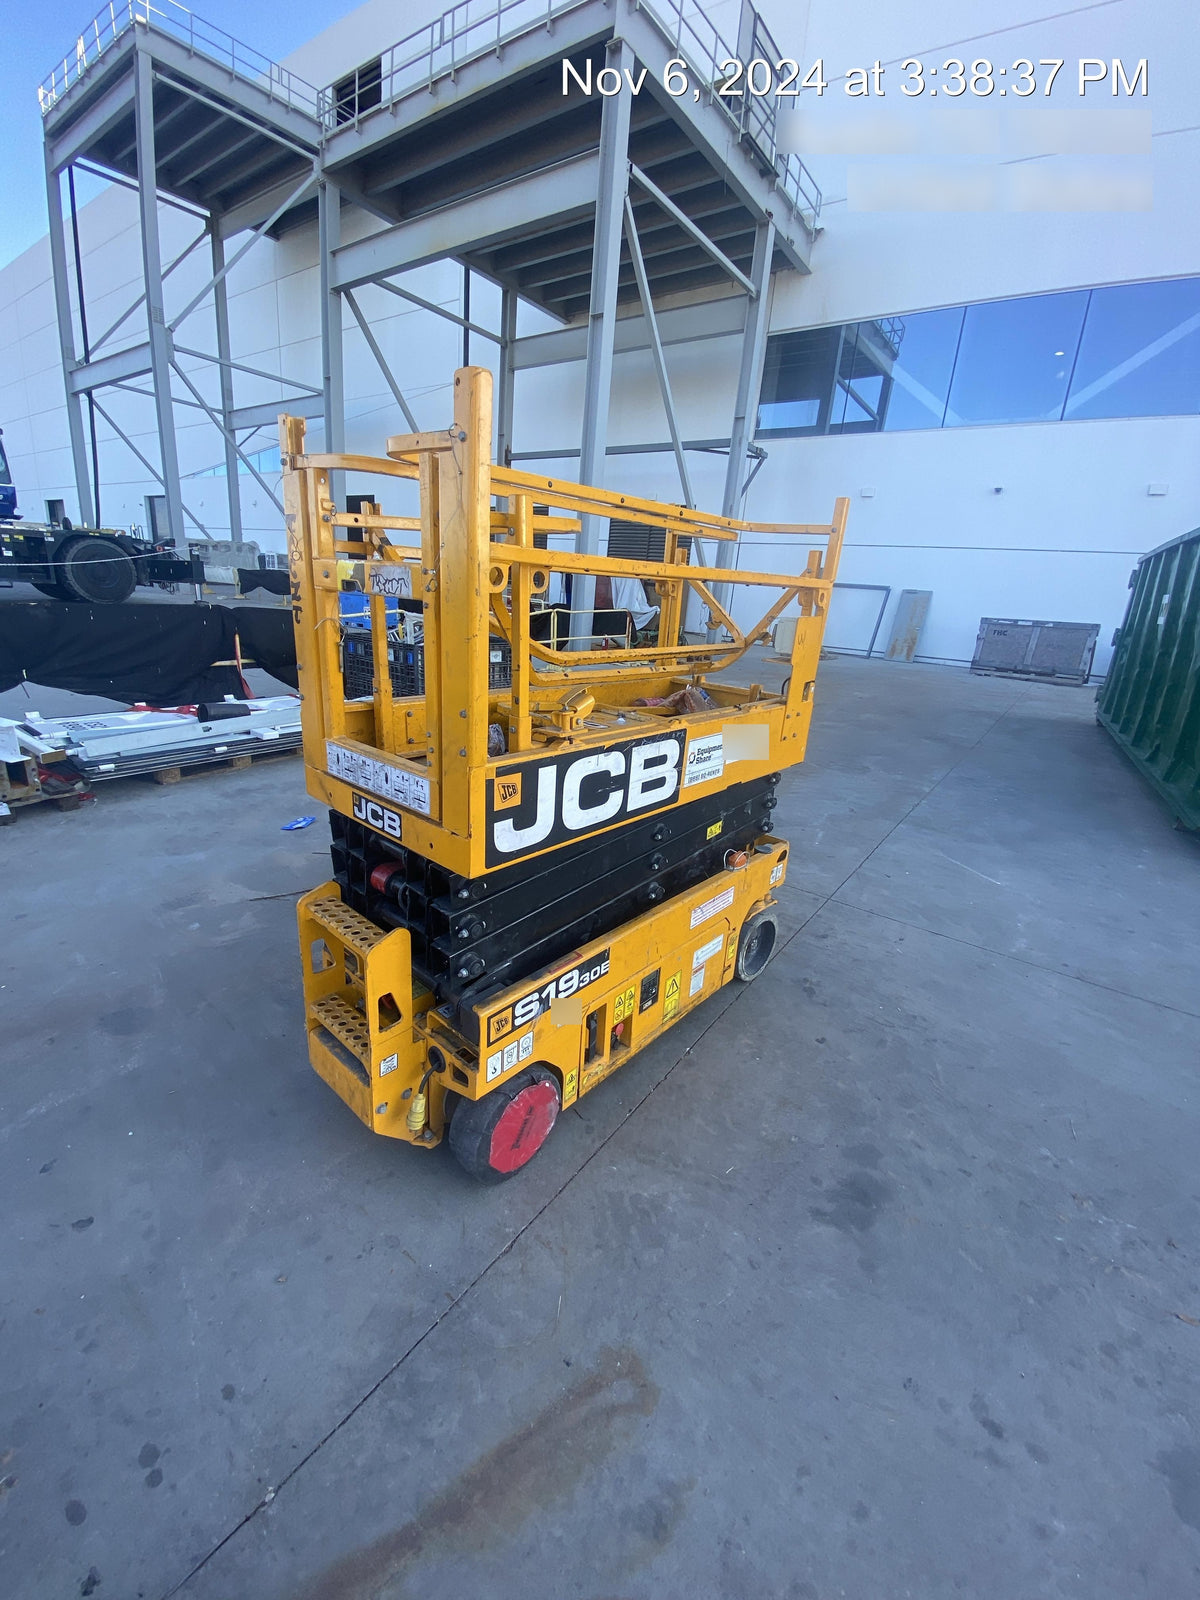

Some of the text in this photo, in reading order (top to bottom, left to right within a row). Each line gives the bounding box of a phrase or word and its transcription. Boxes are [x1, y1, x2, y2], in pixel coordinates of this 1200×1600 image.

[697, 744, 723, 756] Equipmen
[493, 738, 680, 853] JCB
[501, 784, 517, 800] JCB
[353, 797, 402, 838] JCB
